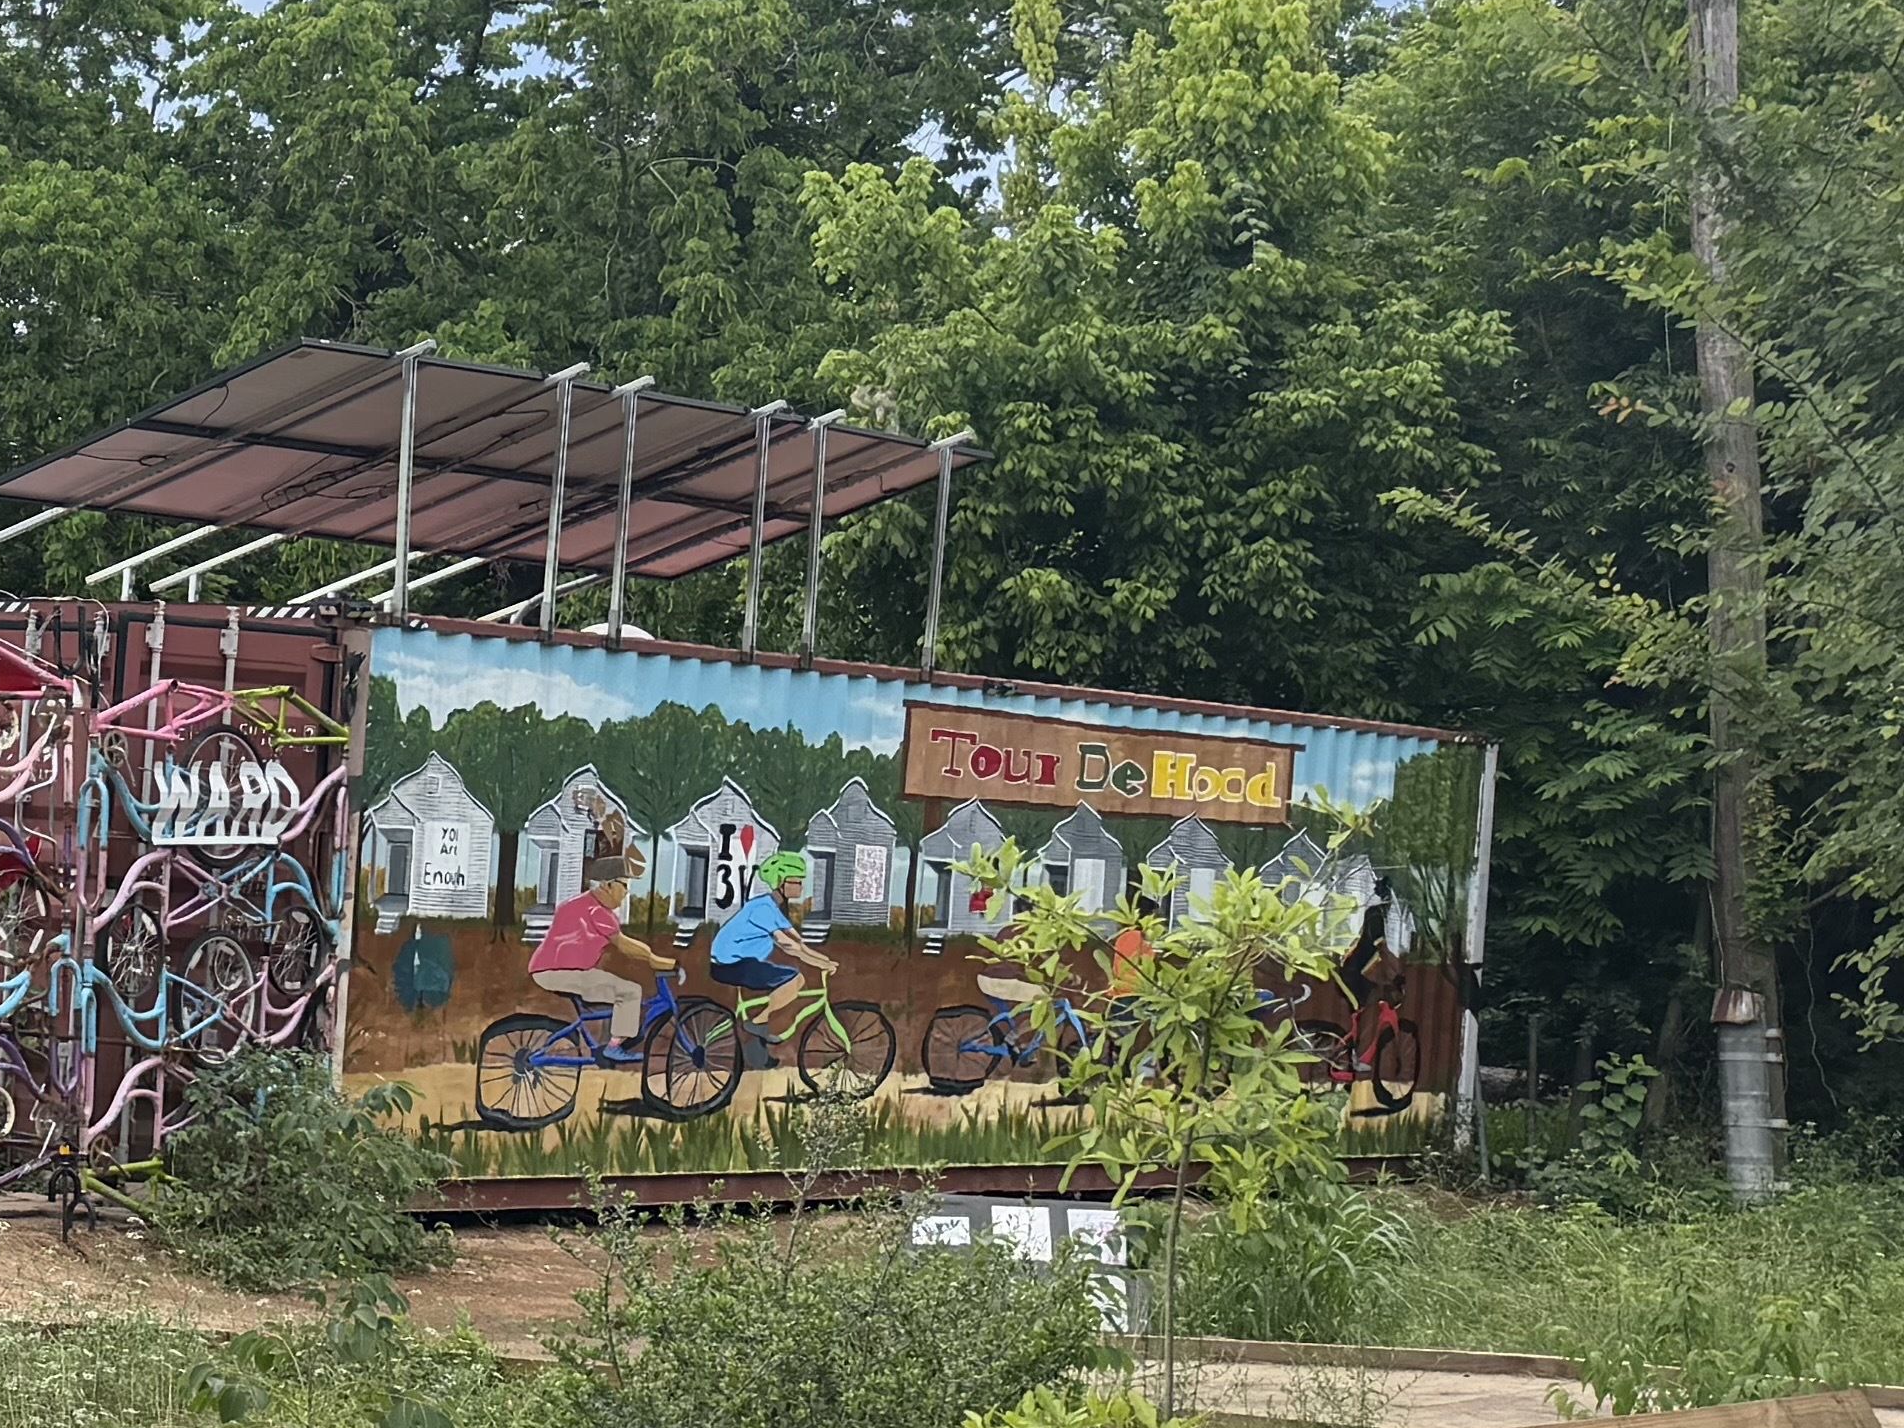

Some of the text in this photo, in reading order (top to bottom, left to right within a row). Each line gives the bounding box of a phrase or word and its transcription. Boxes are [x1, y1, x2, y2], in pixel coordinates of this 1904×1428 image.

[152, 759, 299, 843] WARD
[930, 728, 1281, 807] Tour De Hood
[718, 823, 736, 861] I
